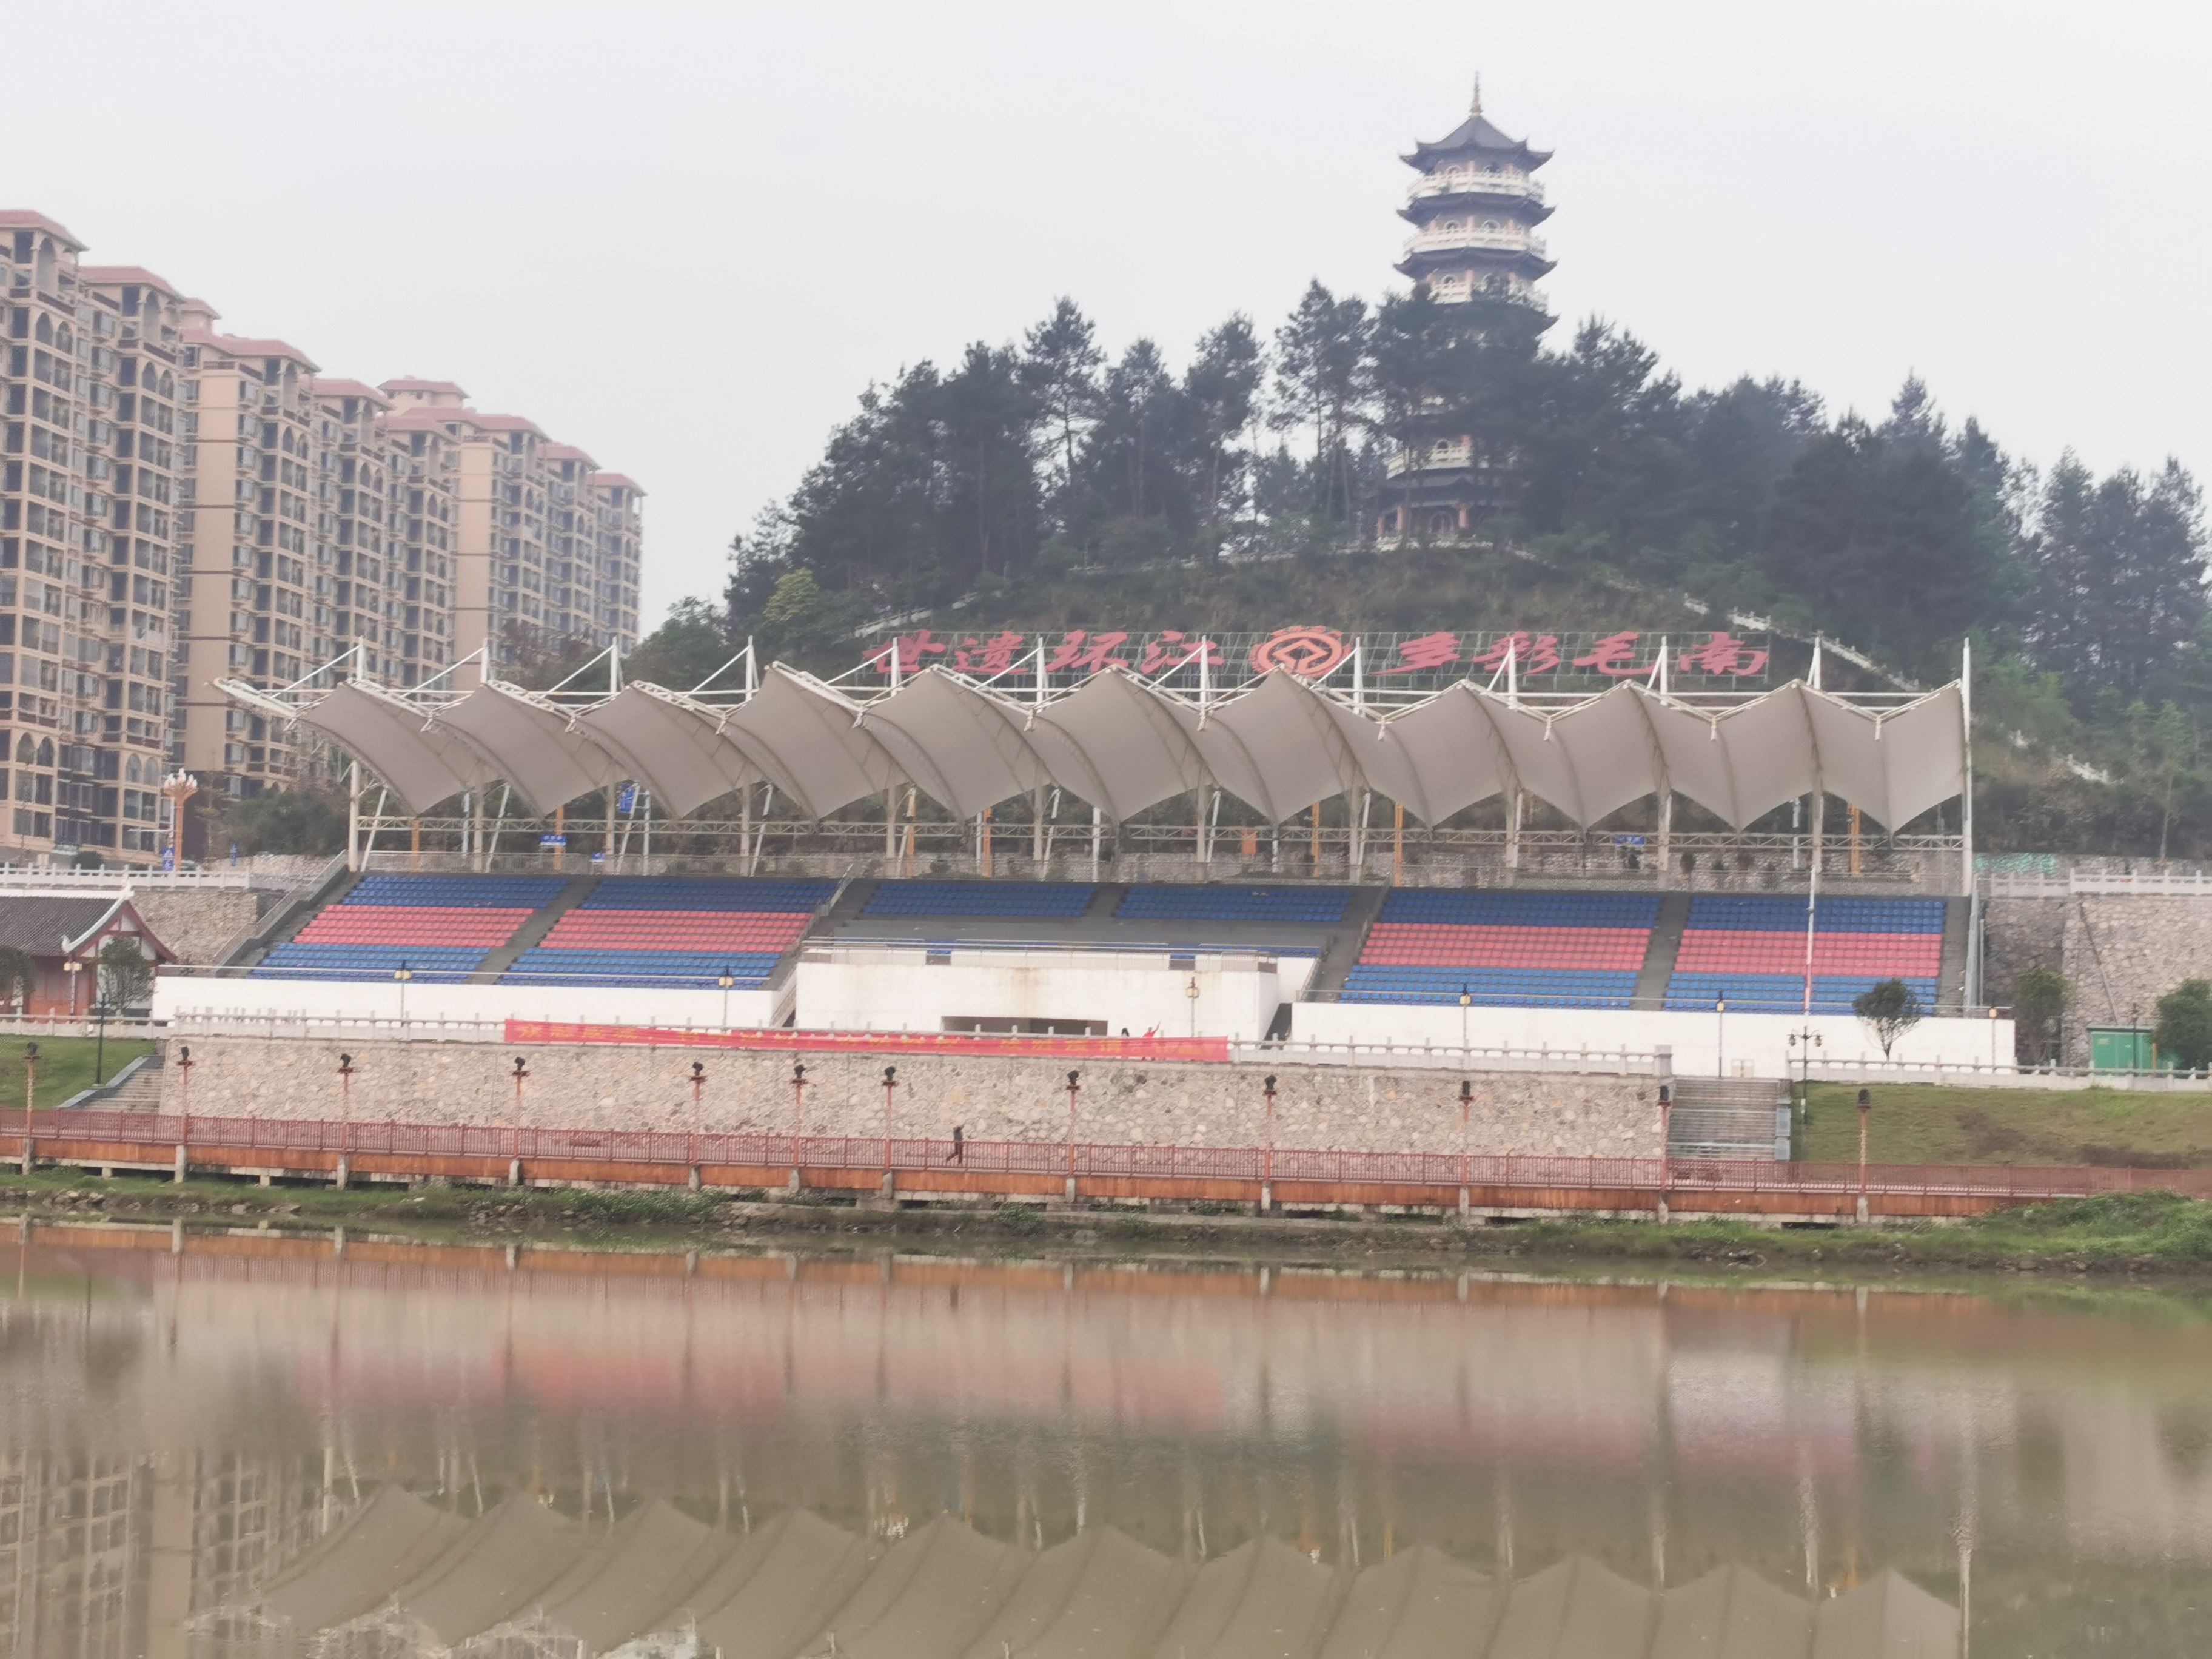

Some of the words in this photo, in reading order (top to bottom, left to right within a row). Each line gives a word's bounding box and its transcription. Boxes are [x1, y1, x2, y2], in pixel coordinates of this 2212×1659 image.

[864, 629, 1224, 674] 世遗环江
[1372, 631, 1769, 676] 多彩毛南
